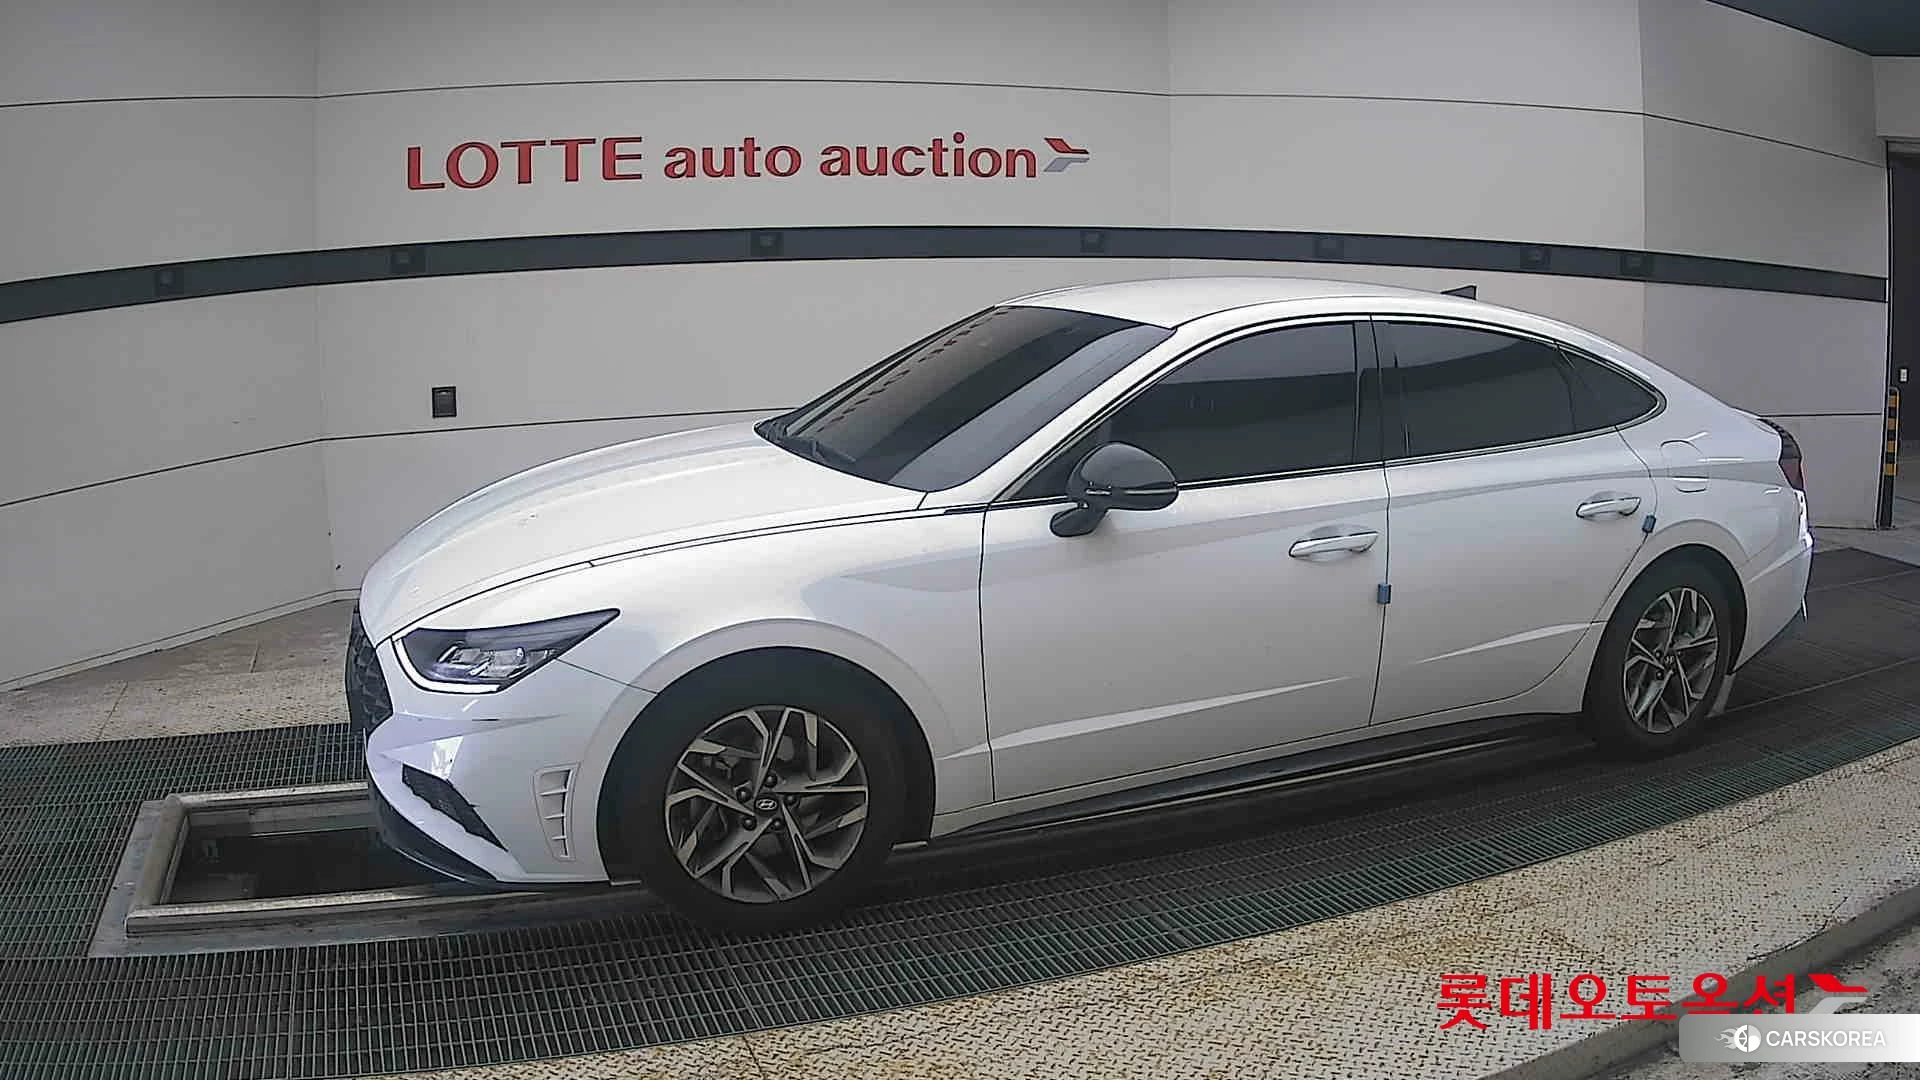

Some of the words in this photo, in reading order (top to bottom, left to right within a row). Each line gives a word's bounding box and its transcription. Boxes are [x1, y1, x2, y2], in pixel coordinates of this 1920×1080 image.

[407, 136, 643, 190] LOTTE
[663, 137, 802, 178] auto
[819, 132, 1037, 179] auction
